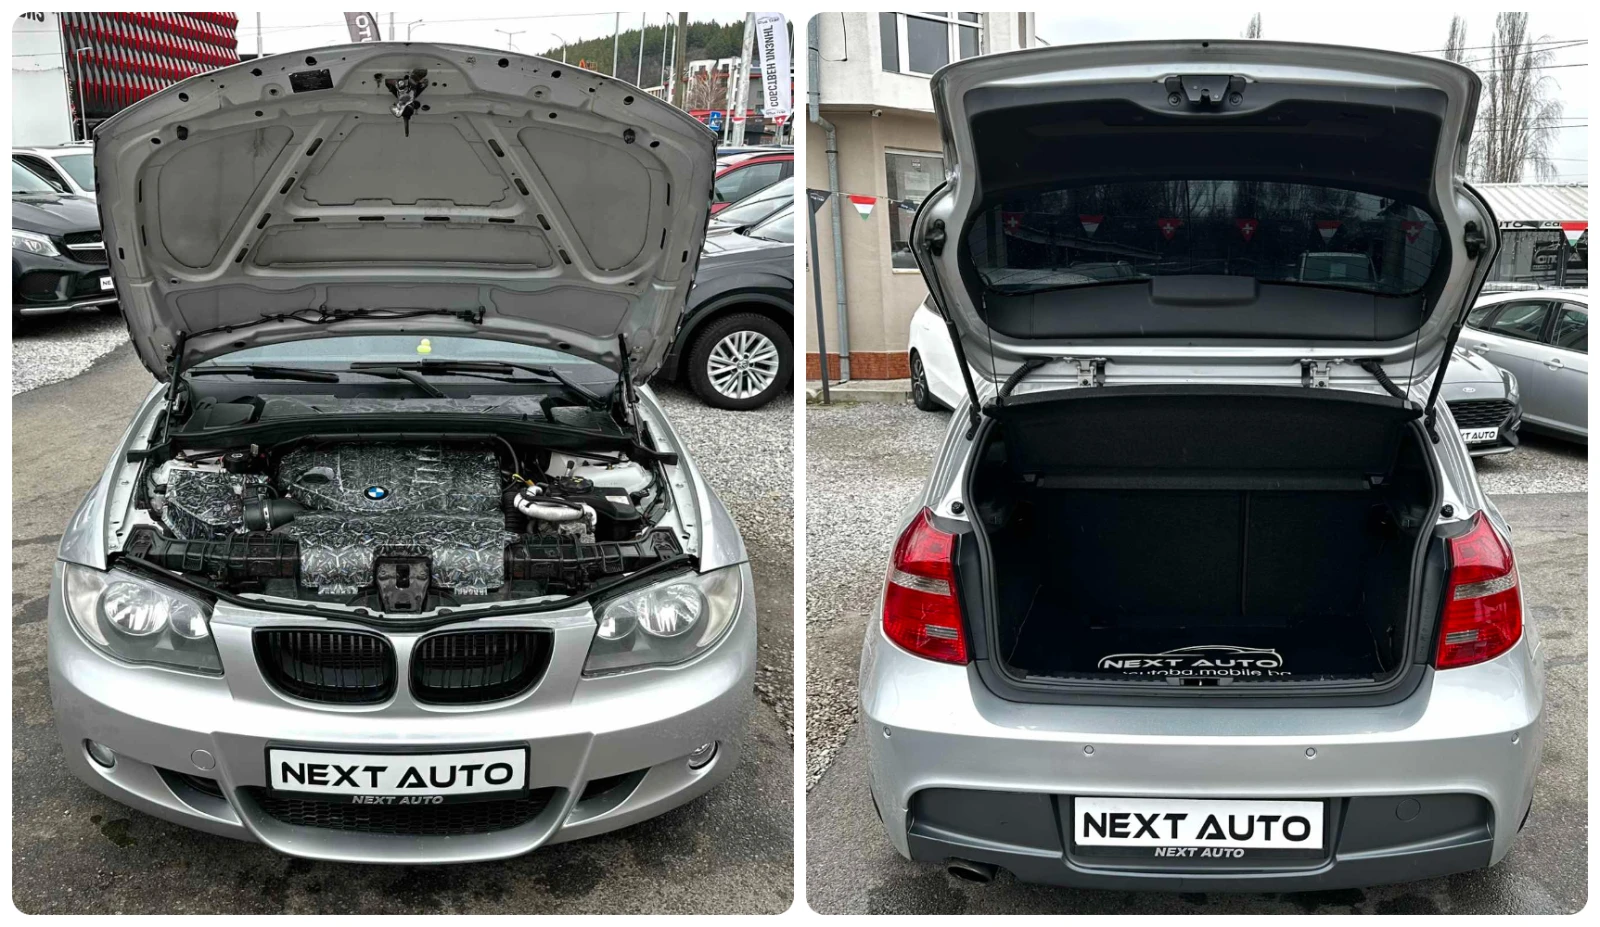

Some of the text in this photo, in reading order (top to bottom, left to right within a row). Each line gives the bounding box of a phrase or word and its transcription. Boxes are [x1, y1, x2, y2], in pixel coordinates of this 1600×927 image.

[1472, 431, 1496, 440] AUTO
[1103, 659, 1279, 669] NEXT AUTO
[281, 761, 513, 789] NEXT AUTO
[352, 795, 444, 805] NEXT AUTO
[1083, 811, 1312, 842] NEXT AUTO
[1154, 847, 1245, 858] NEXT AUTO
